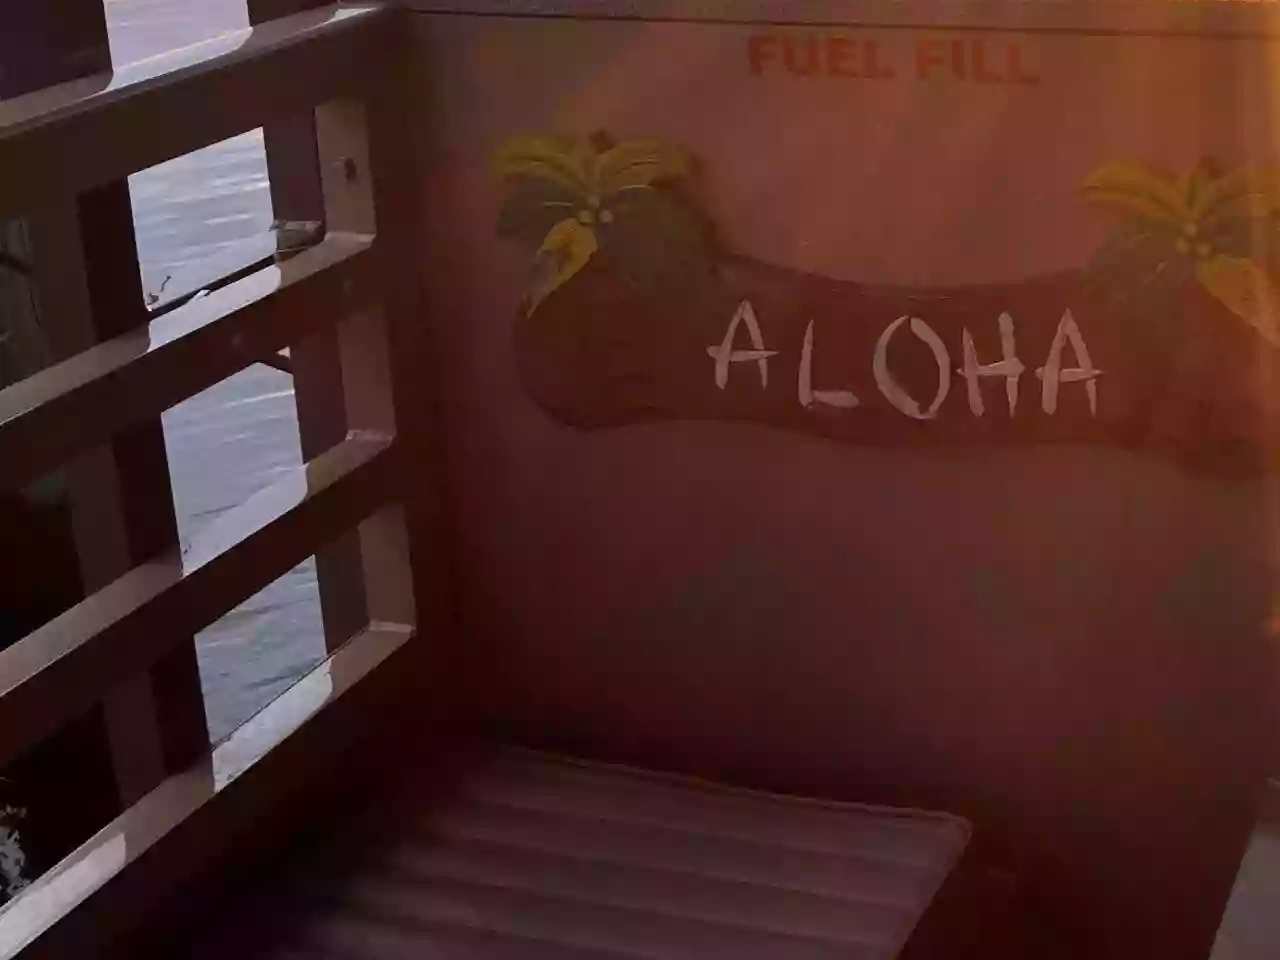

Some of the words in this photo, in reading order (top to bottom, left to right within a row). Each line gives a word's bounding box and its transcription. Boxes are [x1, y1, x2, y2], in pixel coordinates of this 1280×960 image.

[749, 35, 897, 80] FUEL
[915, 39, 1041, 85] FILL
[706, 298, 1105, 420] ALOHA
